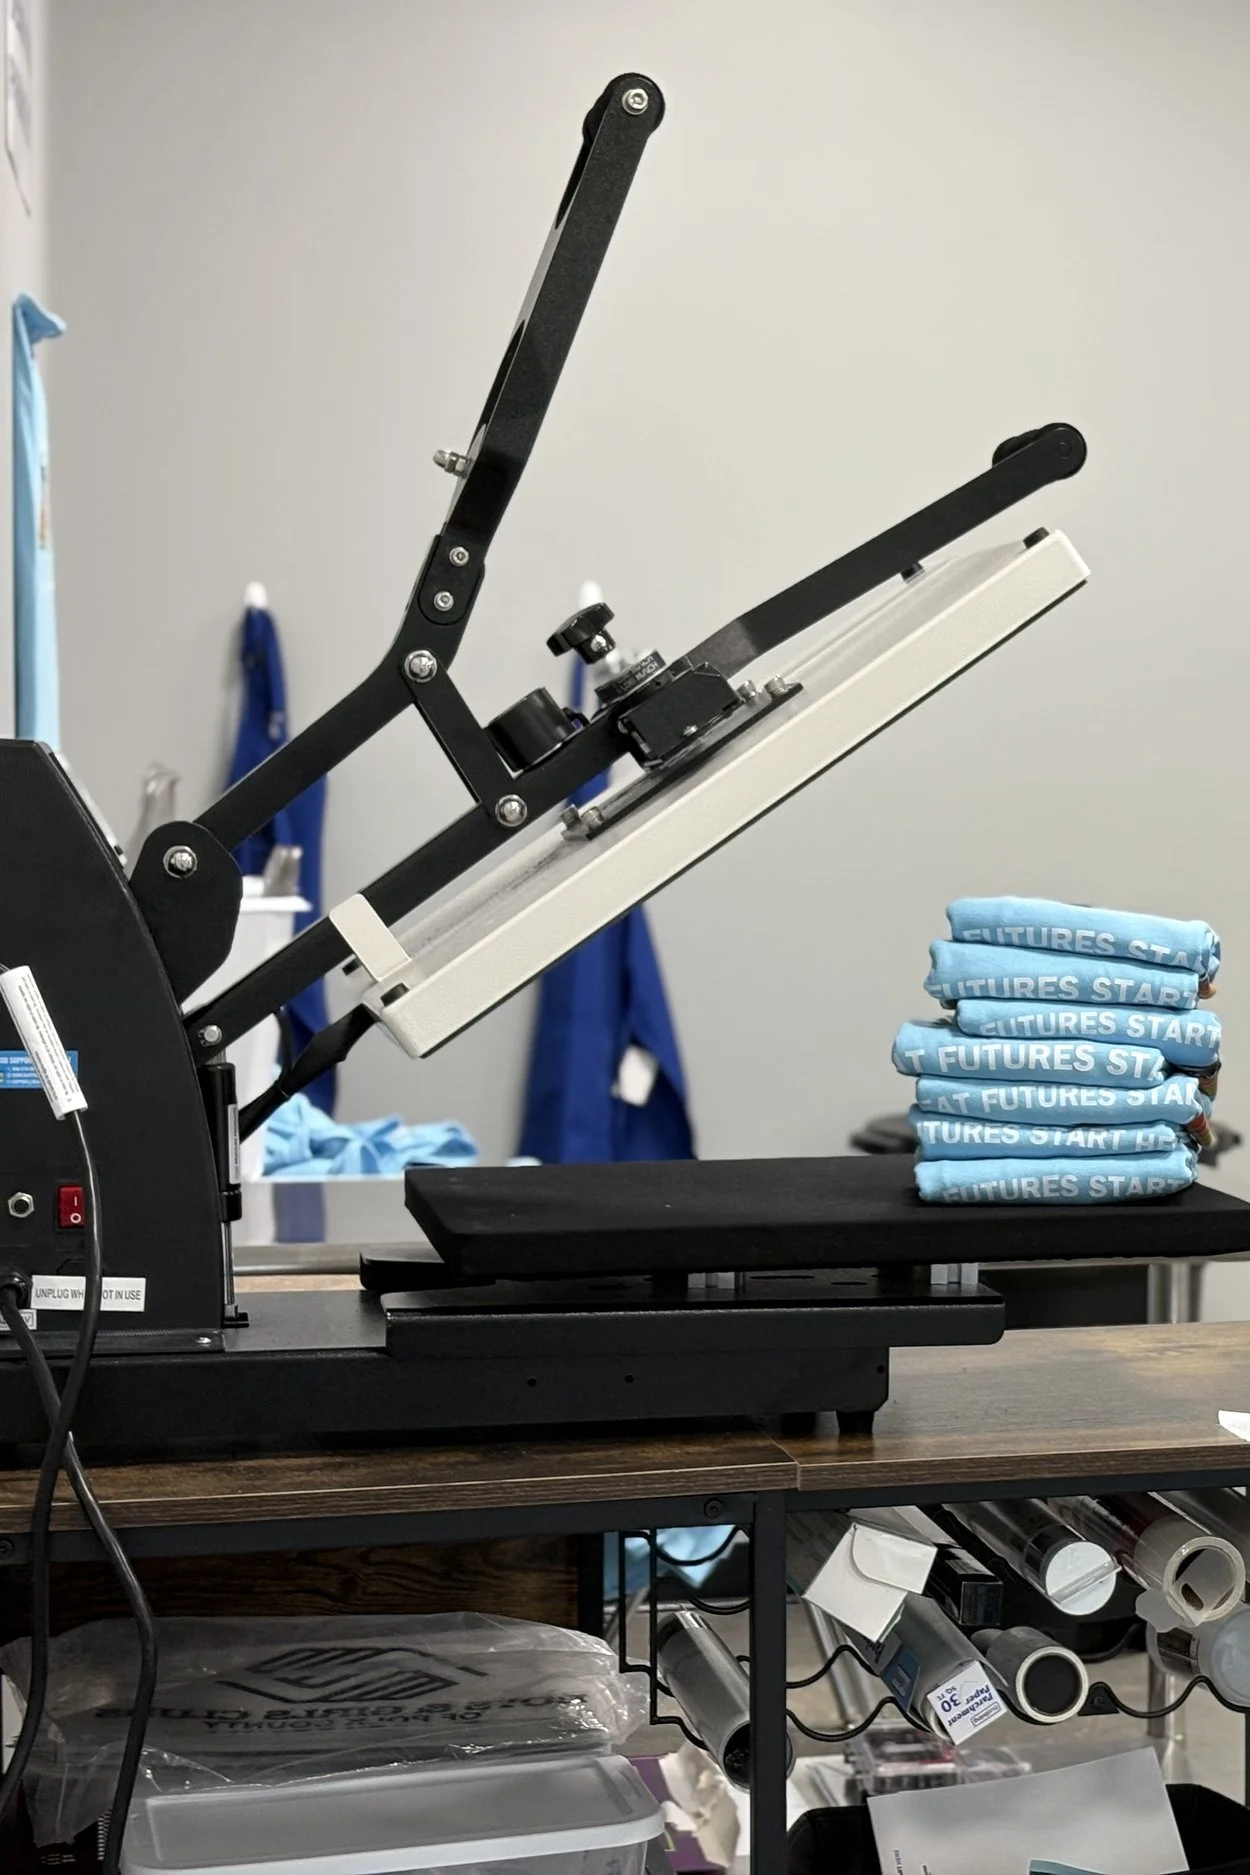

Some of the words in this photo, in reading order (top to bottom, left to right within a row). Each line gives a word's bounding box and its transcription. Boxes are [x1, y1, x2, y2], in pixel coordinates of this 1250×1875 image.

[962, 926, 1115, 956] FUTURES
[1091, 977, 1197, 1009] START
[979, 1011, 1117, 1037] FUTURES
[1126, 1014, 1220, 1049] START
[938, 1043, 1096, 1073] FUTURES
[981, 1085, 1117, 1114] FUTURES
[1029, 1124, 1127, 1151] START
[943, 1174, 1079, 1202] FUTURES
[1088, 1175, 1186, 1198] START
[35, 1287, 69, 1300] UNPLUG
[71, 1287, 84, 1300] WH
[101, 1289, 114, 1301] OT
[115, 1289, 123, 1301] IN
[124, 1290, 142, 1301] USE
[940, 1693, 961, 1713] 30
[965, 1684, 990, 1705] Paper
[947, 1692, 993, 1727] Parchment
